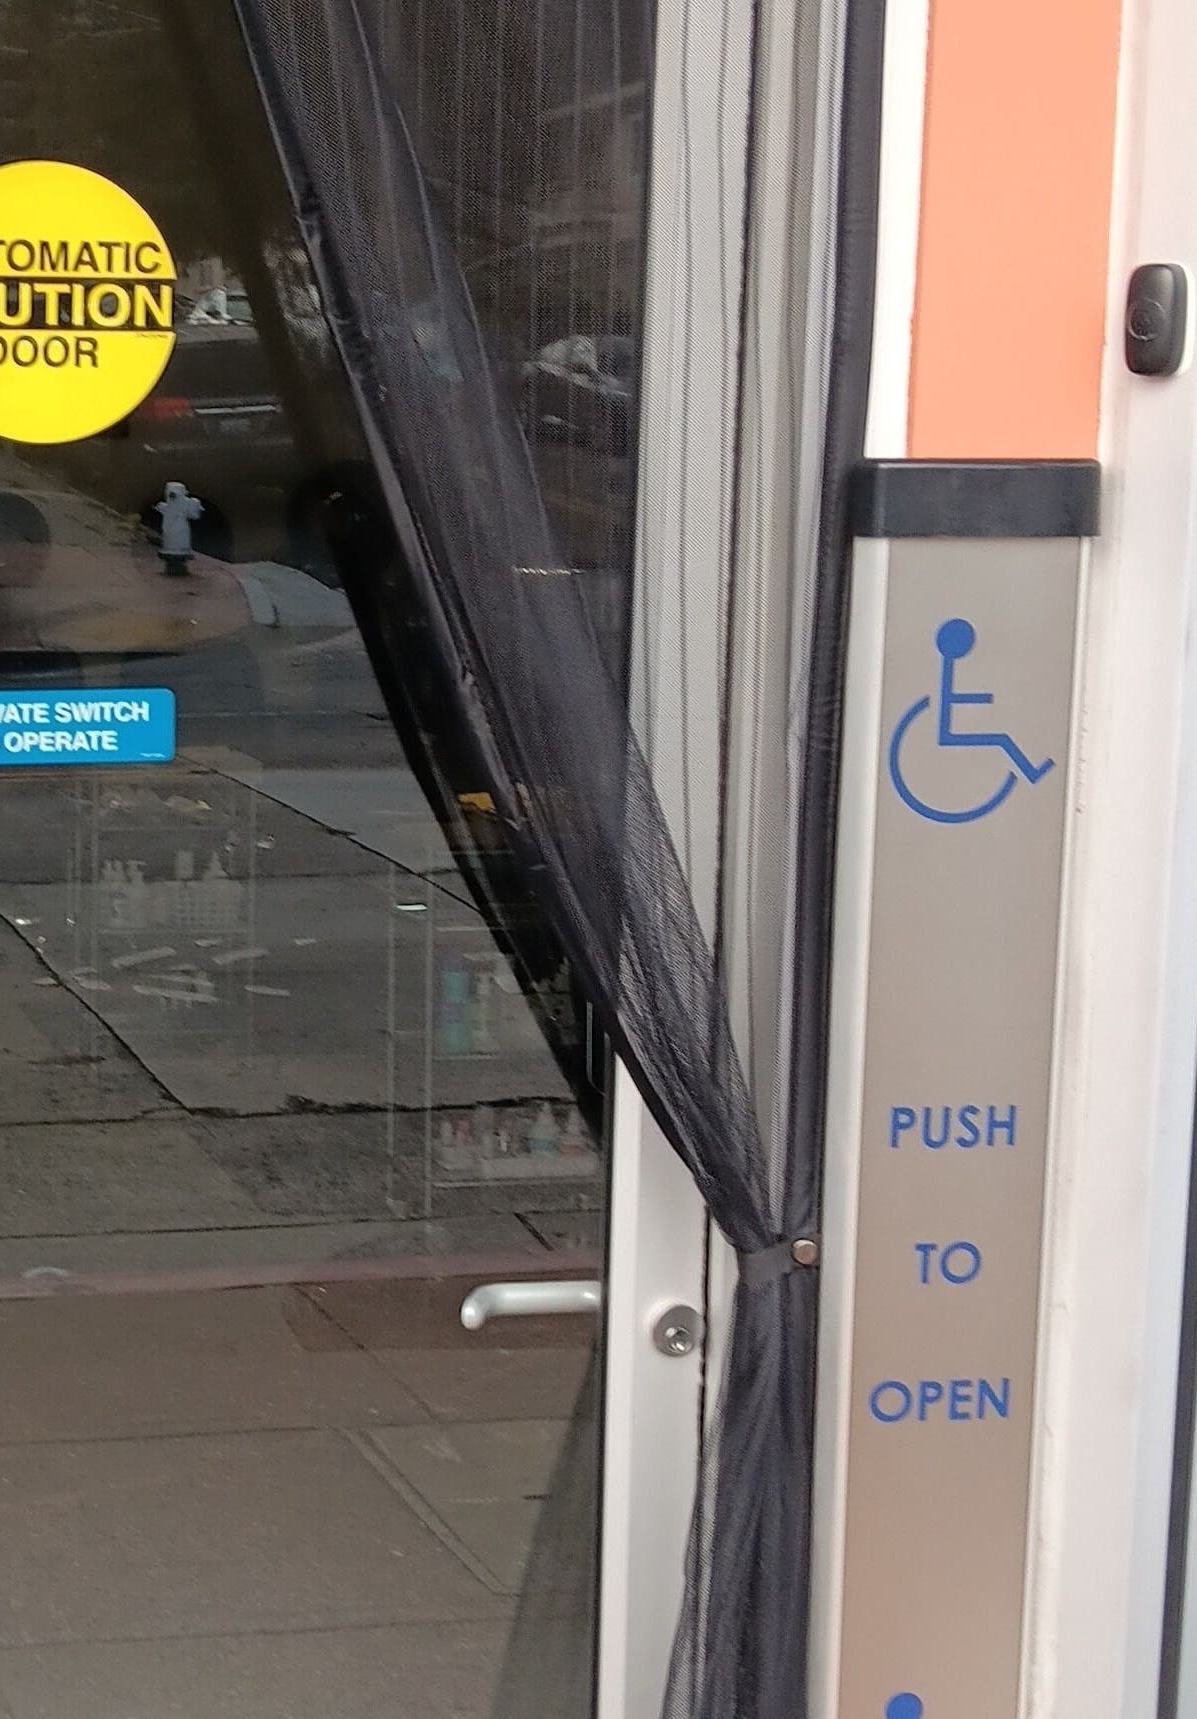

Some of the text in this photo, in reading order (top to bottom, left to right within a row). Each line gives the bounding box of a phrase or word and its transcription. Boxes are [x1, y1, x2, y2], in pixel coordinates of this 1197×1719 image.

[54, 701, 150, 723] SWITCH
[4, 730, 118, 752] OPERATE
[889, 1104, 1017, 1150] PUSH
[914, 1241, 982, 1285] TO
[869, 1377, 1010, 1424] OPEN
